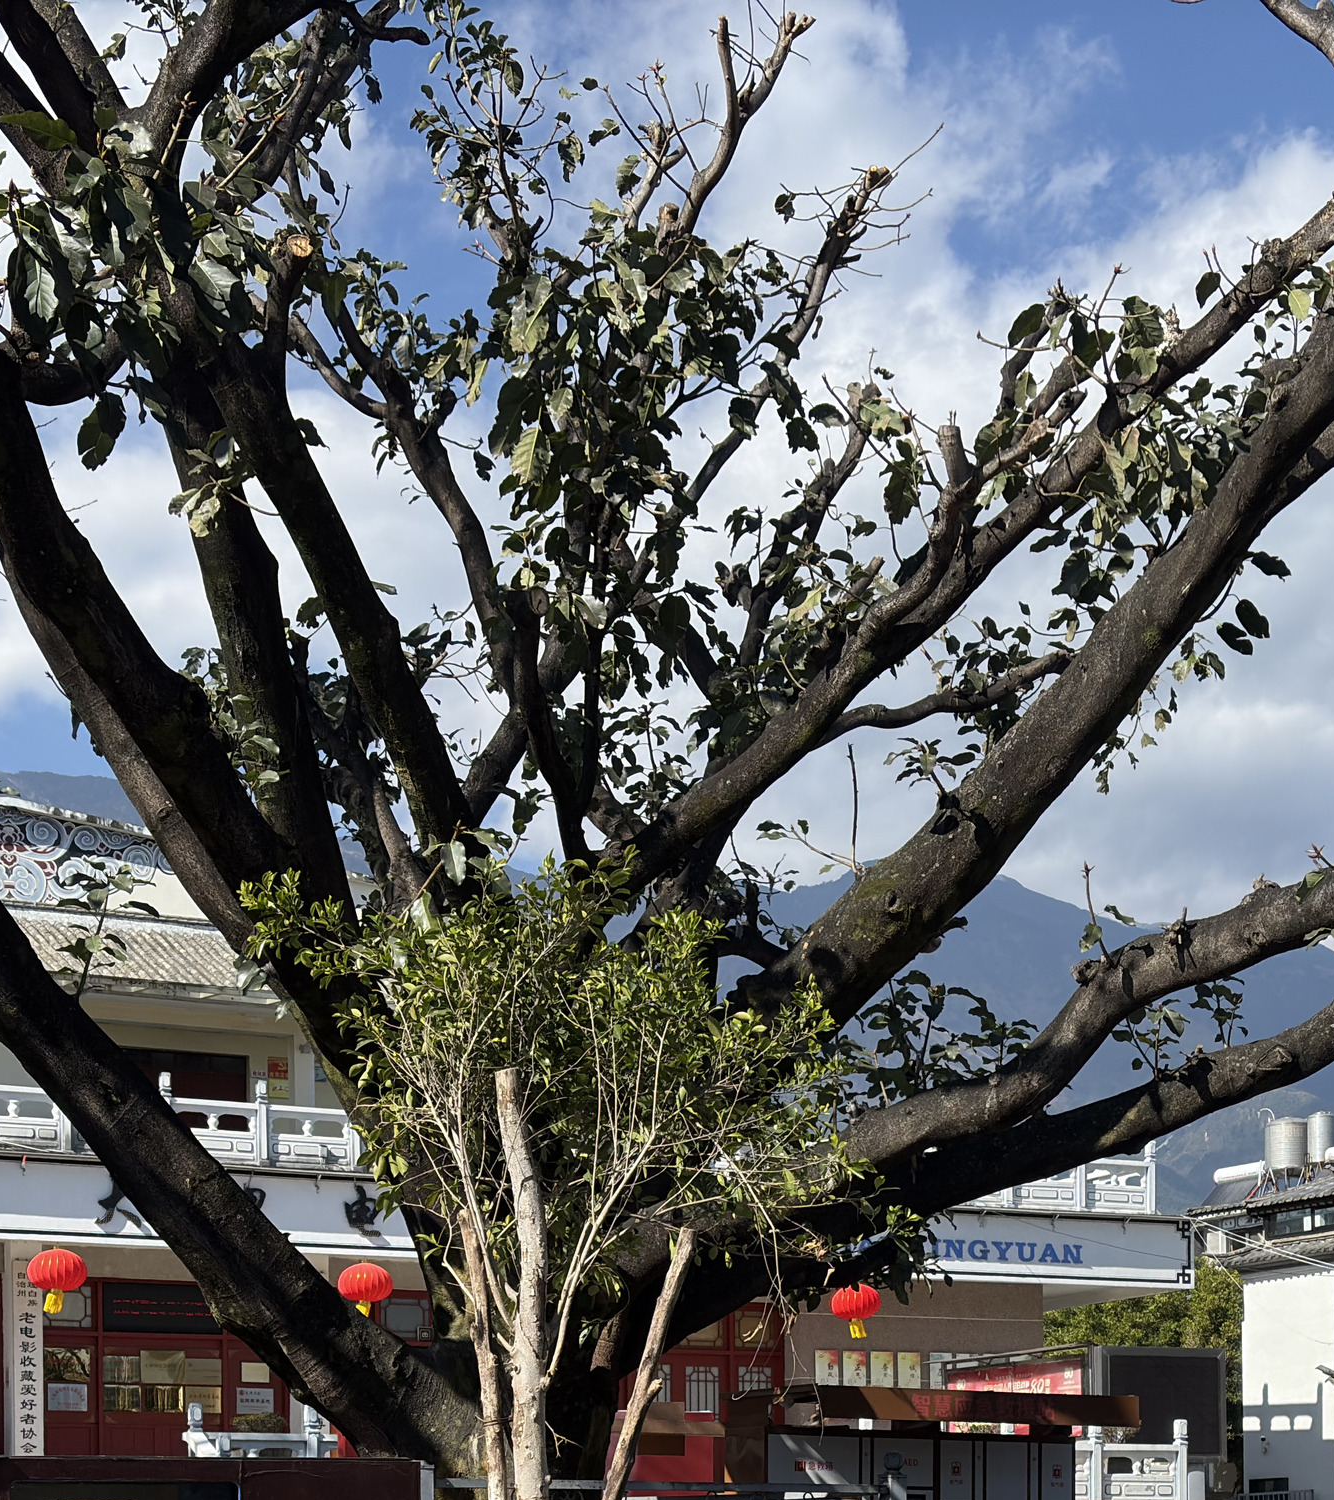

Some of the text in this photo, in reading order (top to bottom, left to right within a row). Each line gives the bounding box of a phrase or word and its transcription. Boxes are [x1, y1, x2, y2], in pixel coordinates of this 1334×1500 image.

[19, 1312, 38, 1454] 老电影收藏爱好者协会
[808, 1461, 834, 1471] 急救箱
